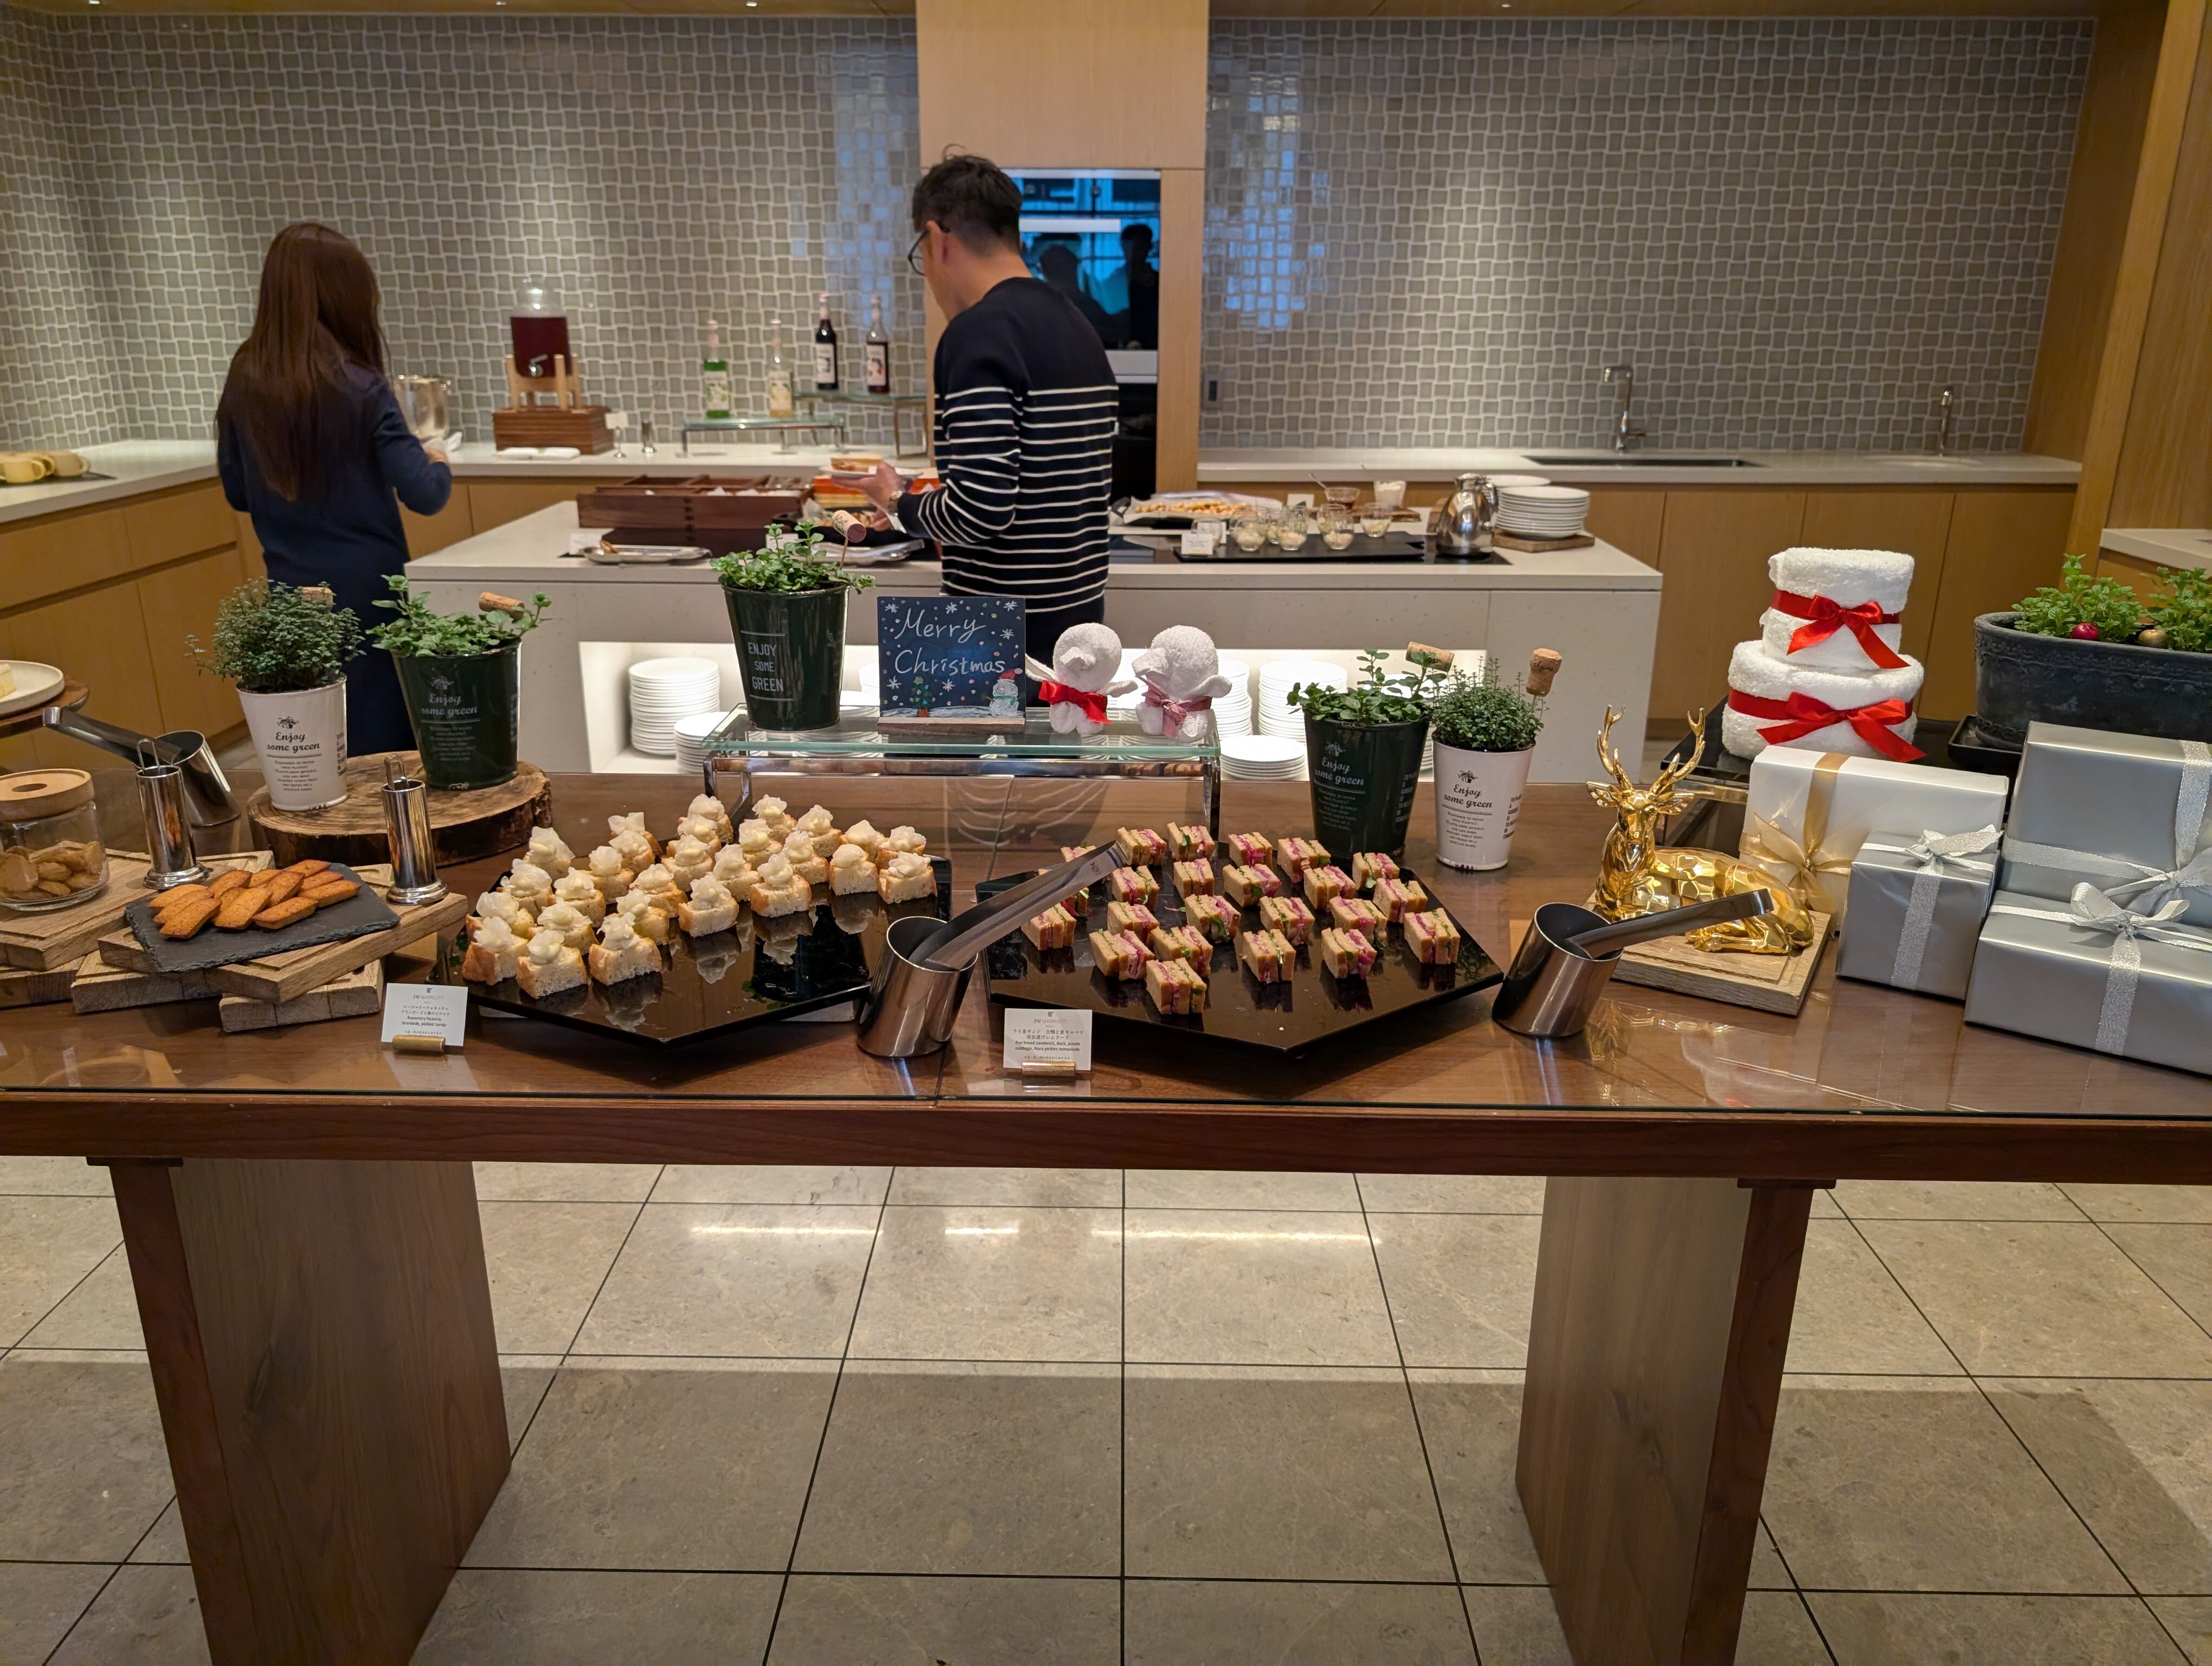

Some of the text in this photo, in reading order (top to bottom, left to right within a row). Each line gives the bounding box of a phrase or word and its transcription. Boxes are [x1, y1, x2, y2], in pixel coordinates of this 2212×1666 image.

[894, 608, 987, 644] Merry
[748, 642, 777, 656] ENJOY
[754, 661, 775, 672] SOME
[895, 647, 1006, 676] Christmas
[751, 676, 784, 692] GREEN
[429, 693, 462, 706] Enjoy
[422, 707, 478, 718] some green
[275, 732, 306, 743] Enjoy
[292, 743, 320, 754] green
[1322, 757, 1351, 774] Enjoy
[1315, 769, 1365, 785] some green
[1454, 784, 1481, 798] Enjoy
[1444, 794, 1493, 809] some green
